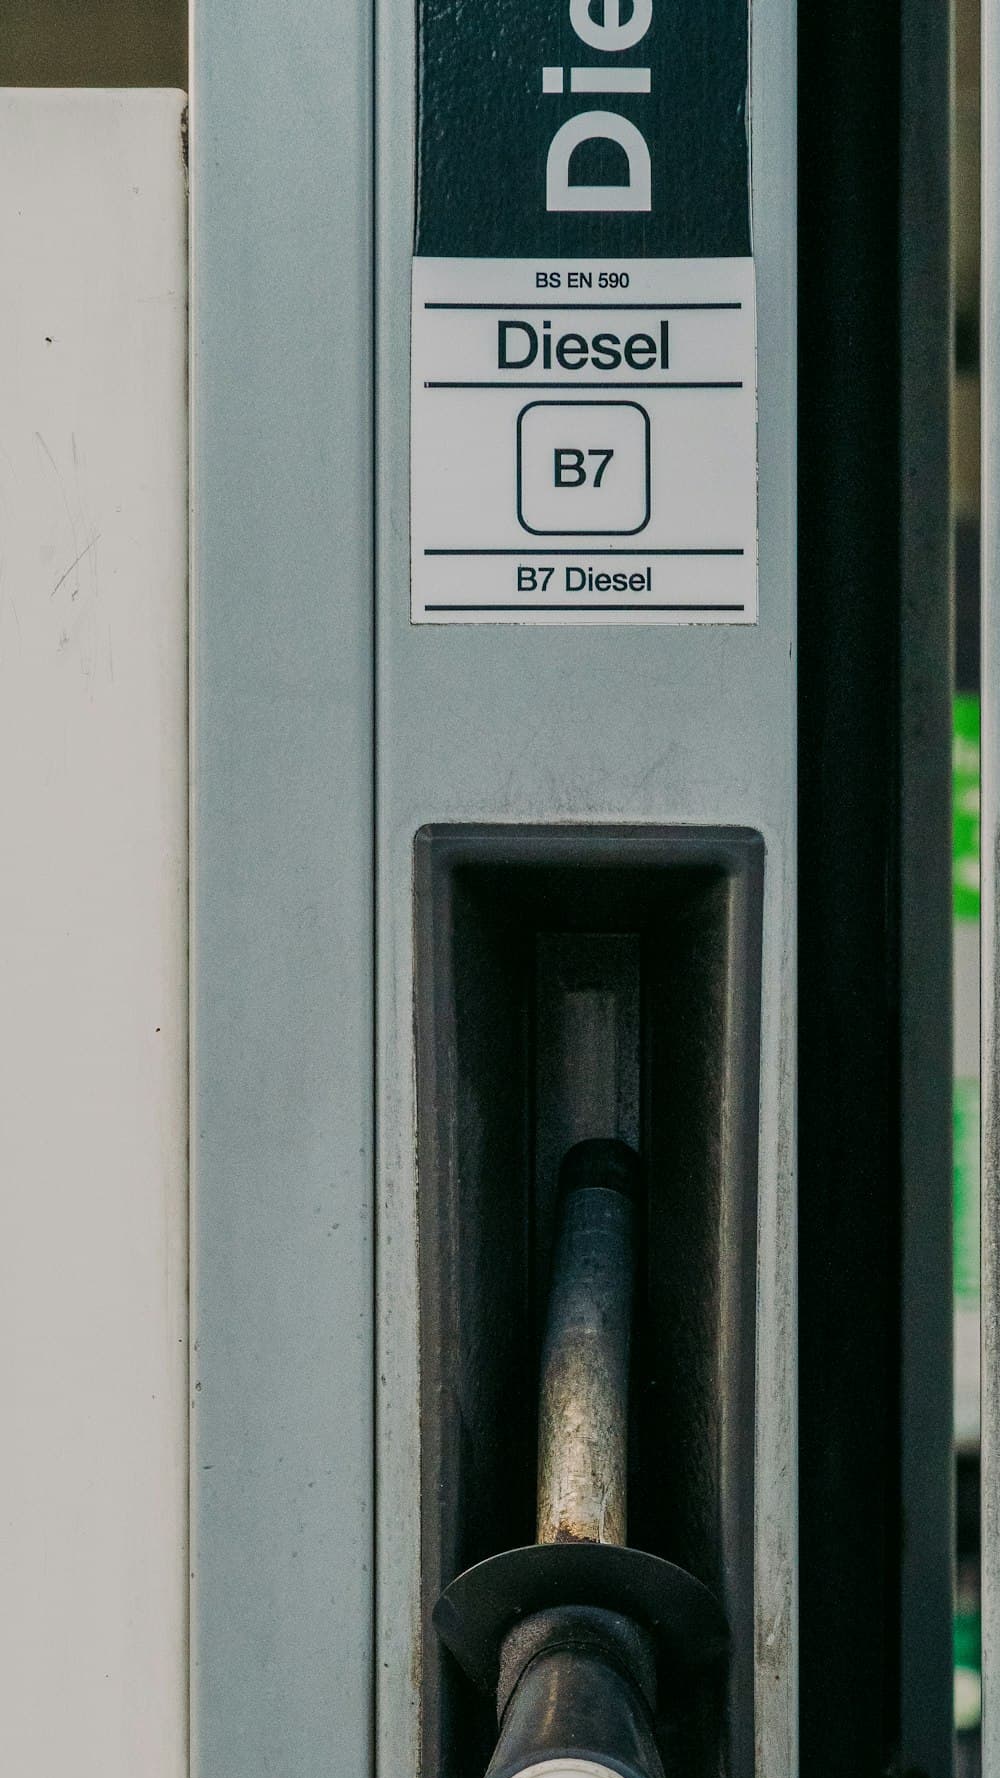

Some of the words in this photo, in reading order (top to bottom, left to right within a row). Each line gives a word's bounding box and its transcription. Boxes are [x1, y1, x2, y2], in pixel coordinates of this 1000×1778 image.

[536, 272, 561, 288] BS
[568, 273, 592, 288] EN
[599, 273, 629, 288] 590
[498, 320, 668, 370] Diesel
[555, 449, 613, 487] B7
[518, 567, 554, 591] B7
[566, 567, 651, 591] Diesel
